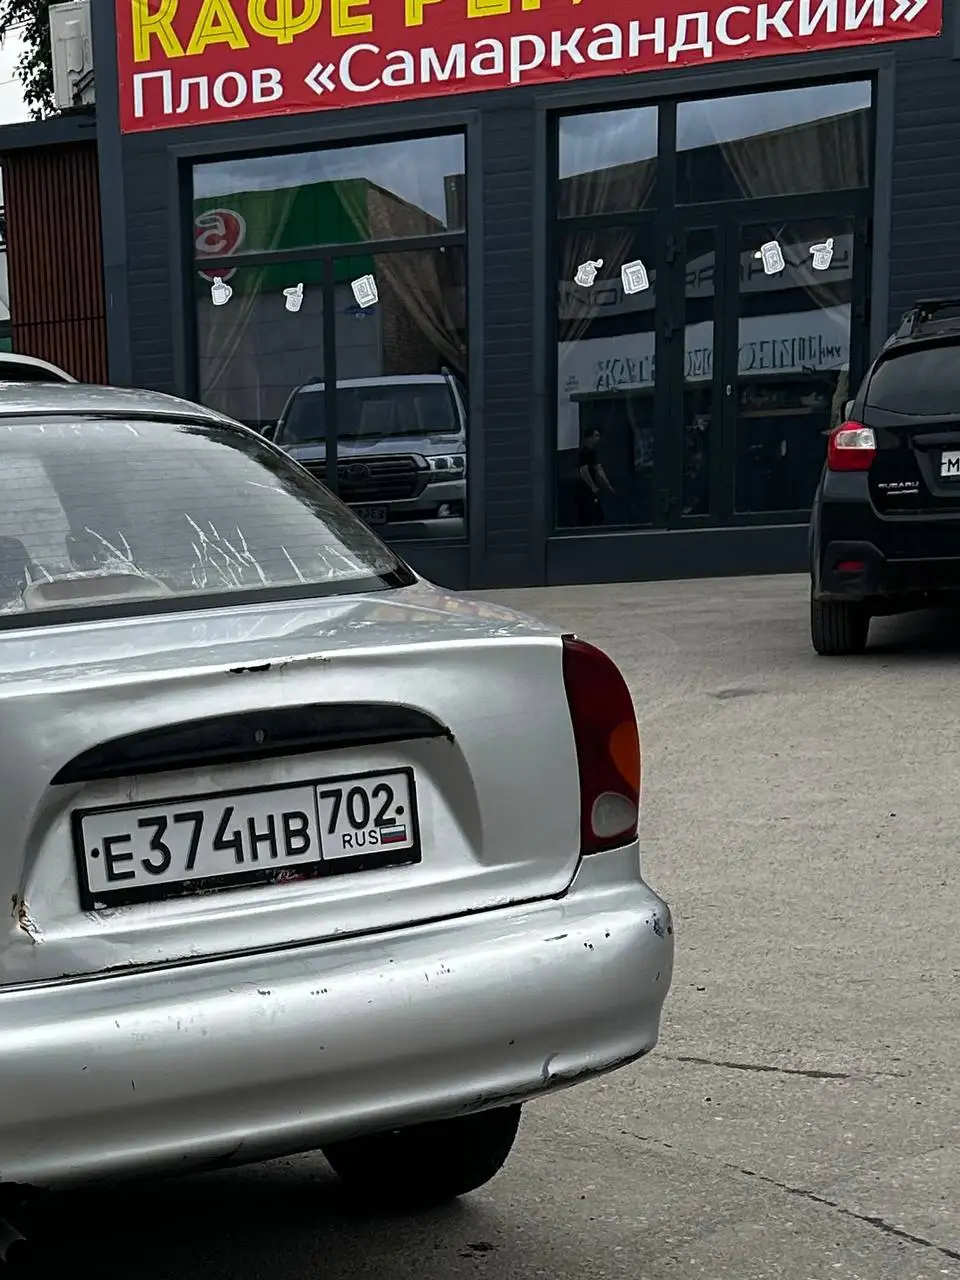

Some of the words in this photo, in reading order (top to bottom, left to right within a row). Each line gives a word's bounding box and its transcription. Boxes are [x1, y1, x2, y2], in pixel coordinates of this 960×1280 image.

[131, 0, 373, 62] КАФЕ
[132, 67, 284, 118] Плов
[319, 783, 397, 835] 702
[342, 829, 379, 849] RUS
